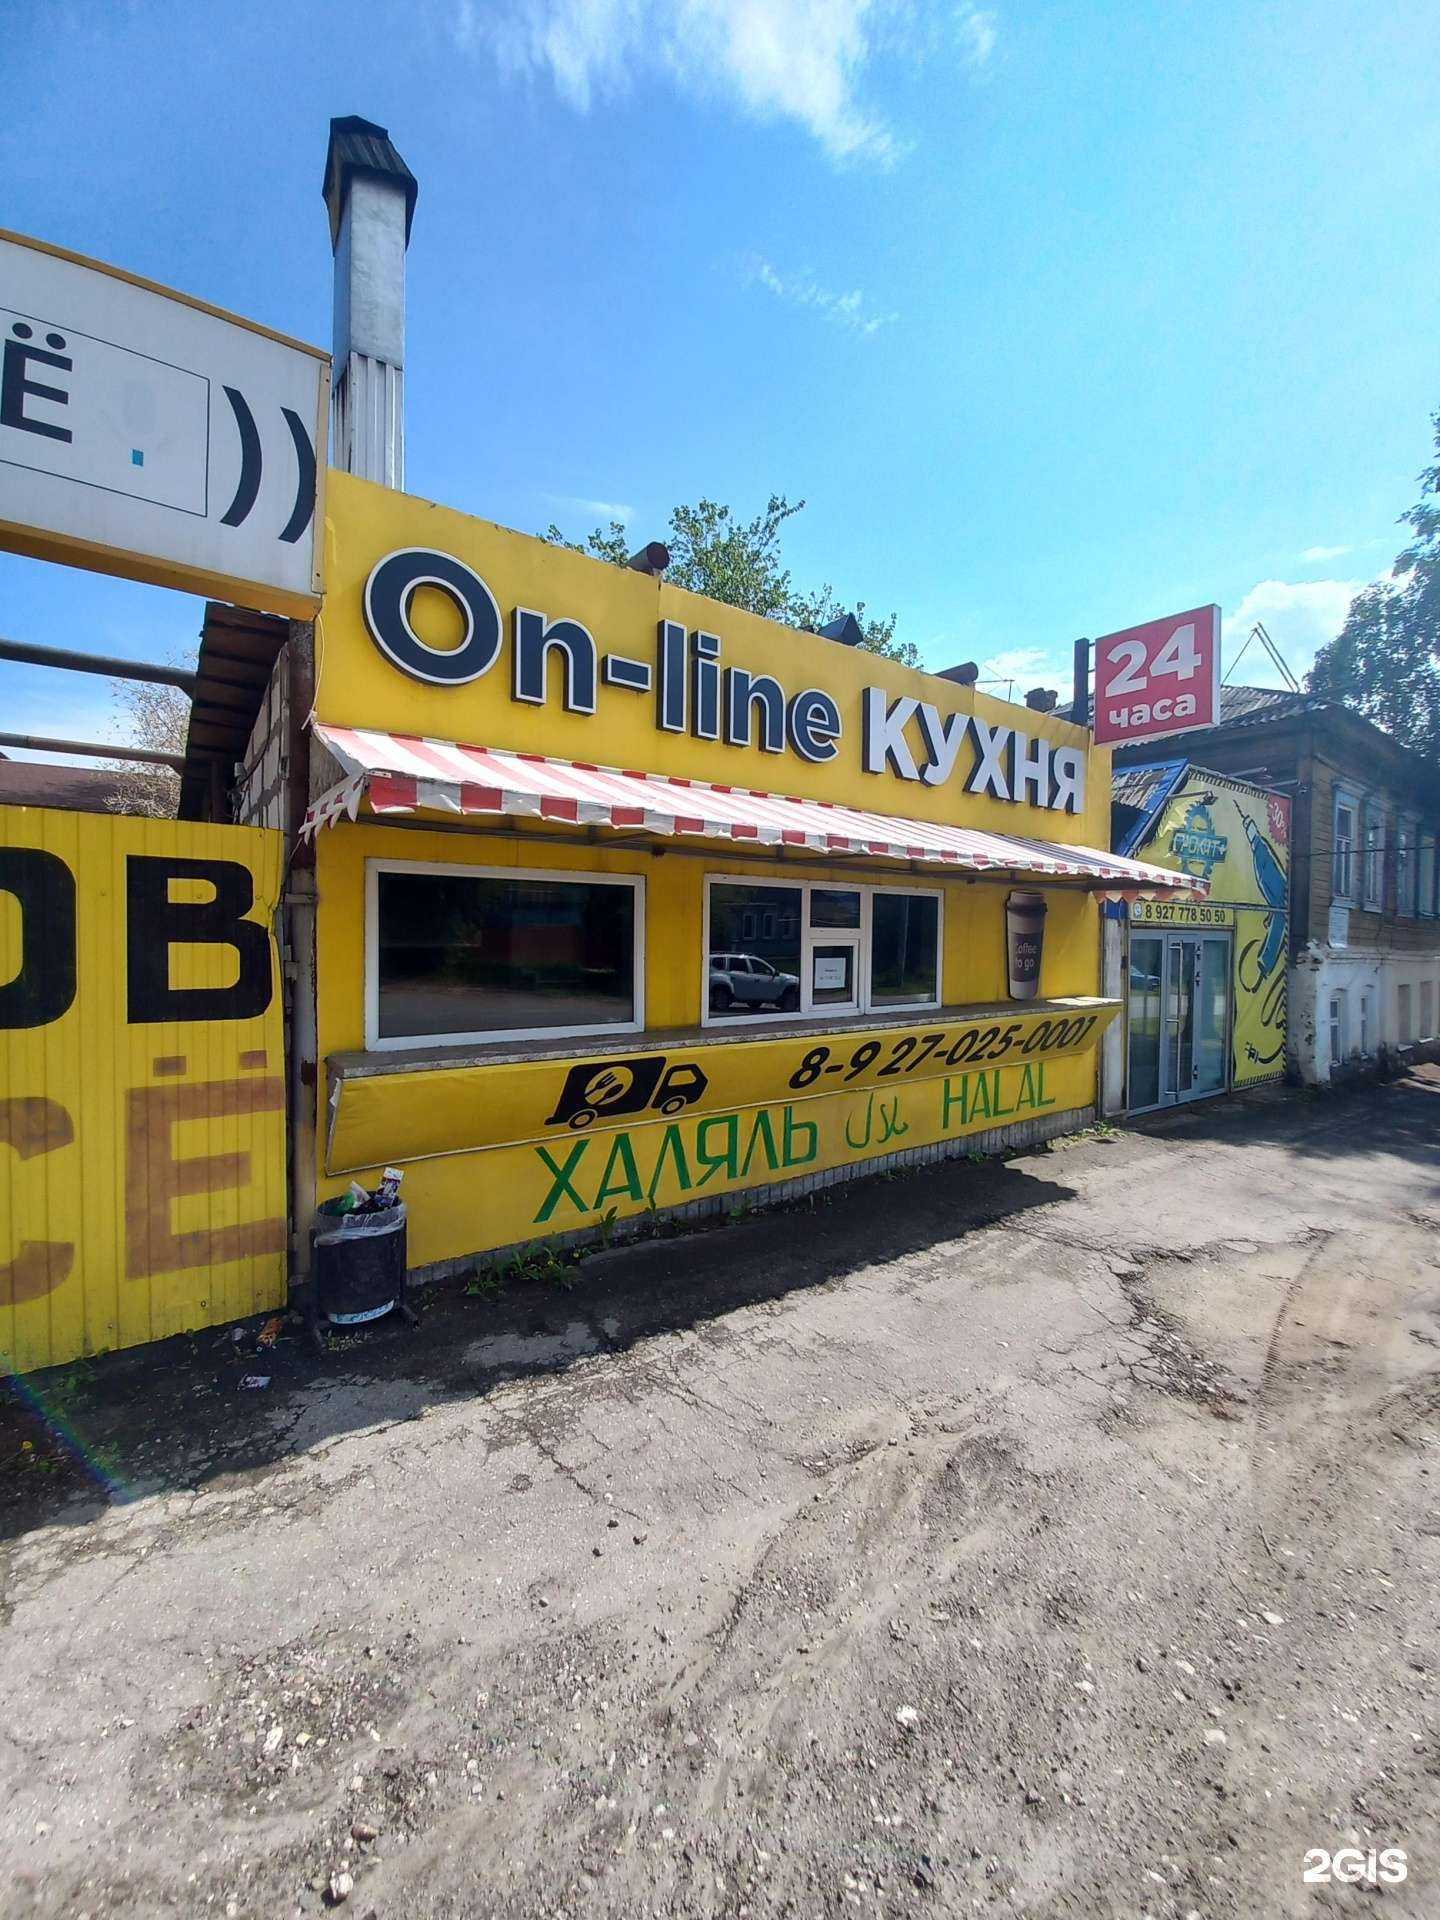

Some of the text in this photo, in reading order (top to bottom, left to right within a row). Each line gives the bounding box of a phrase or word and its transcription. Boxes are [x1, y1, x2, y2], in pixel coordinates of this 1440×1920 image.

[364, 546, 1085, 815] On-line КУХНЯ
[1104, 623, 1202, 698] 24
[1109, 693, 1197, 729] часа
[1145, 904, 1226, 923] 8 927 778 50 50
[532, 1105, 818, 1223] ХАЛЯЛЬ
[942, 1063, 1056, 1129] HALAL
